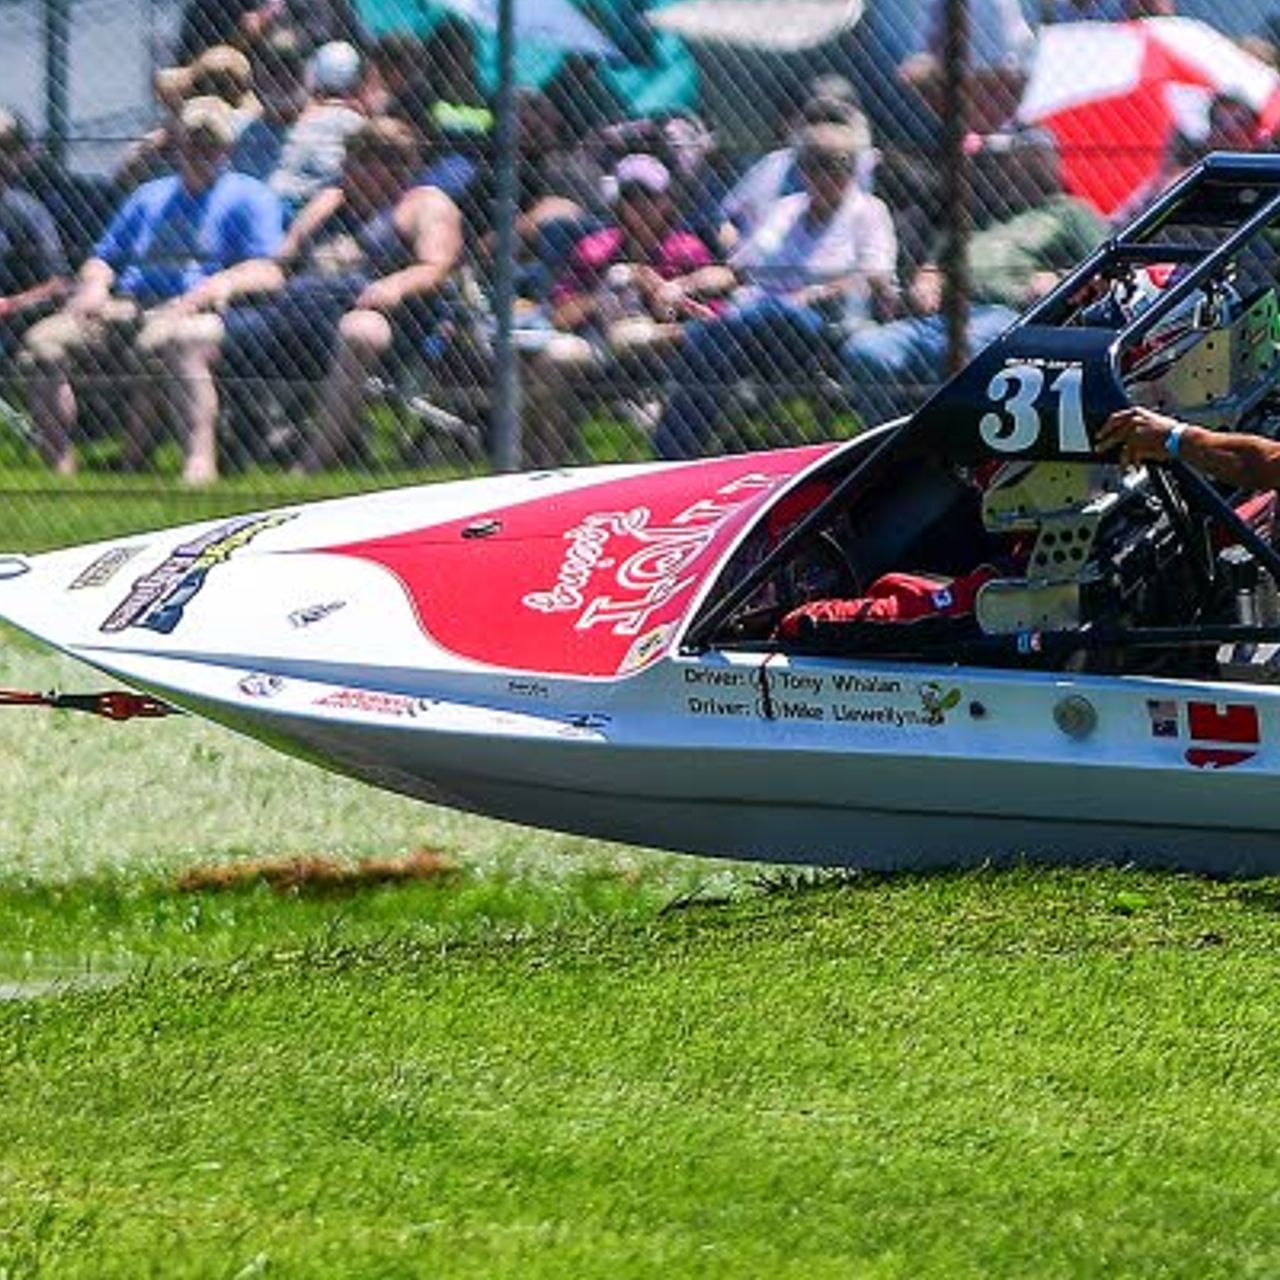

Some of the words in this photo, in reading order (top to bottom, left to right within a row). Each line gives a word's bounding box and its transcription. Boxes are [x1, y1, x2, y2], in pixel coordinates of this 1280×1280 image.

[979, 365, 1092, 452] 31
[684, 669, 744, 690] Driver:
[781, 673, 823, 695] Tony
[832, 675, 901, 694] Whalan
[688, 696, 750, 716] Driver:
[783, 701, 824, 719] Mike
